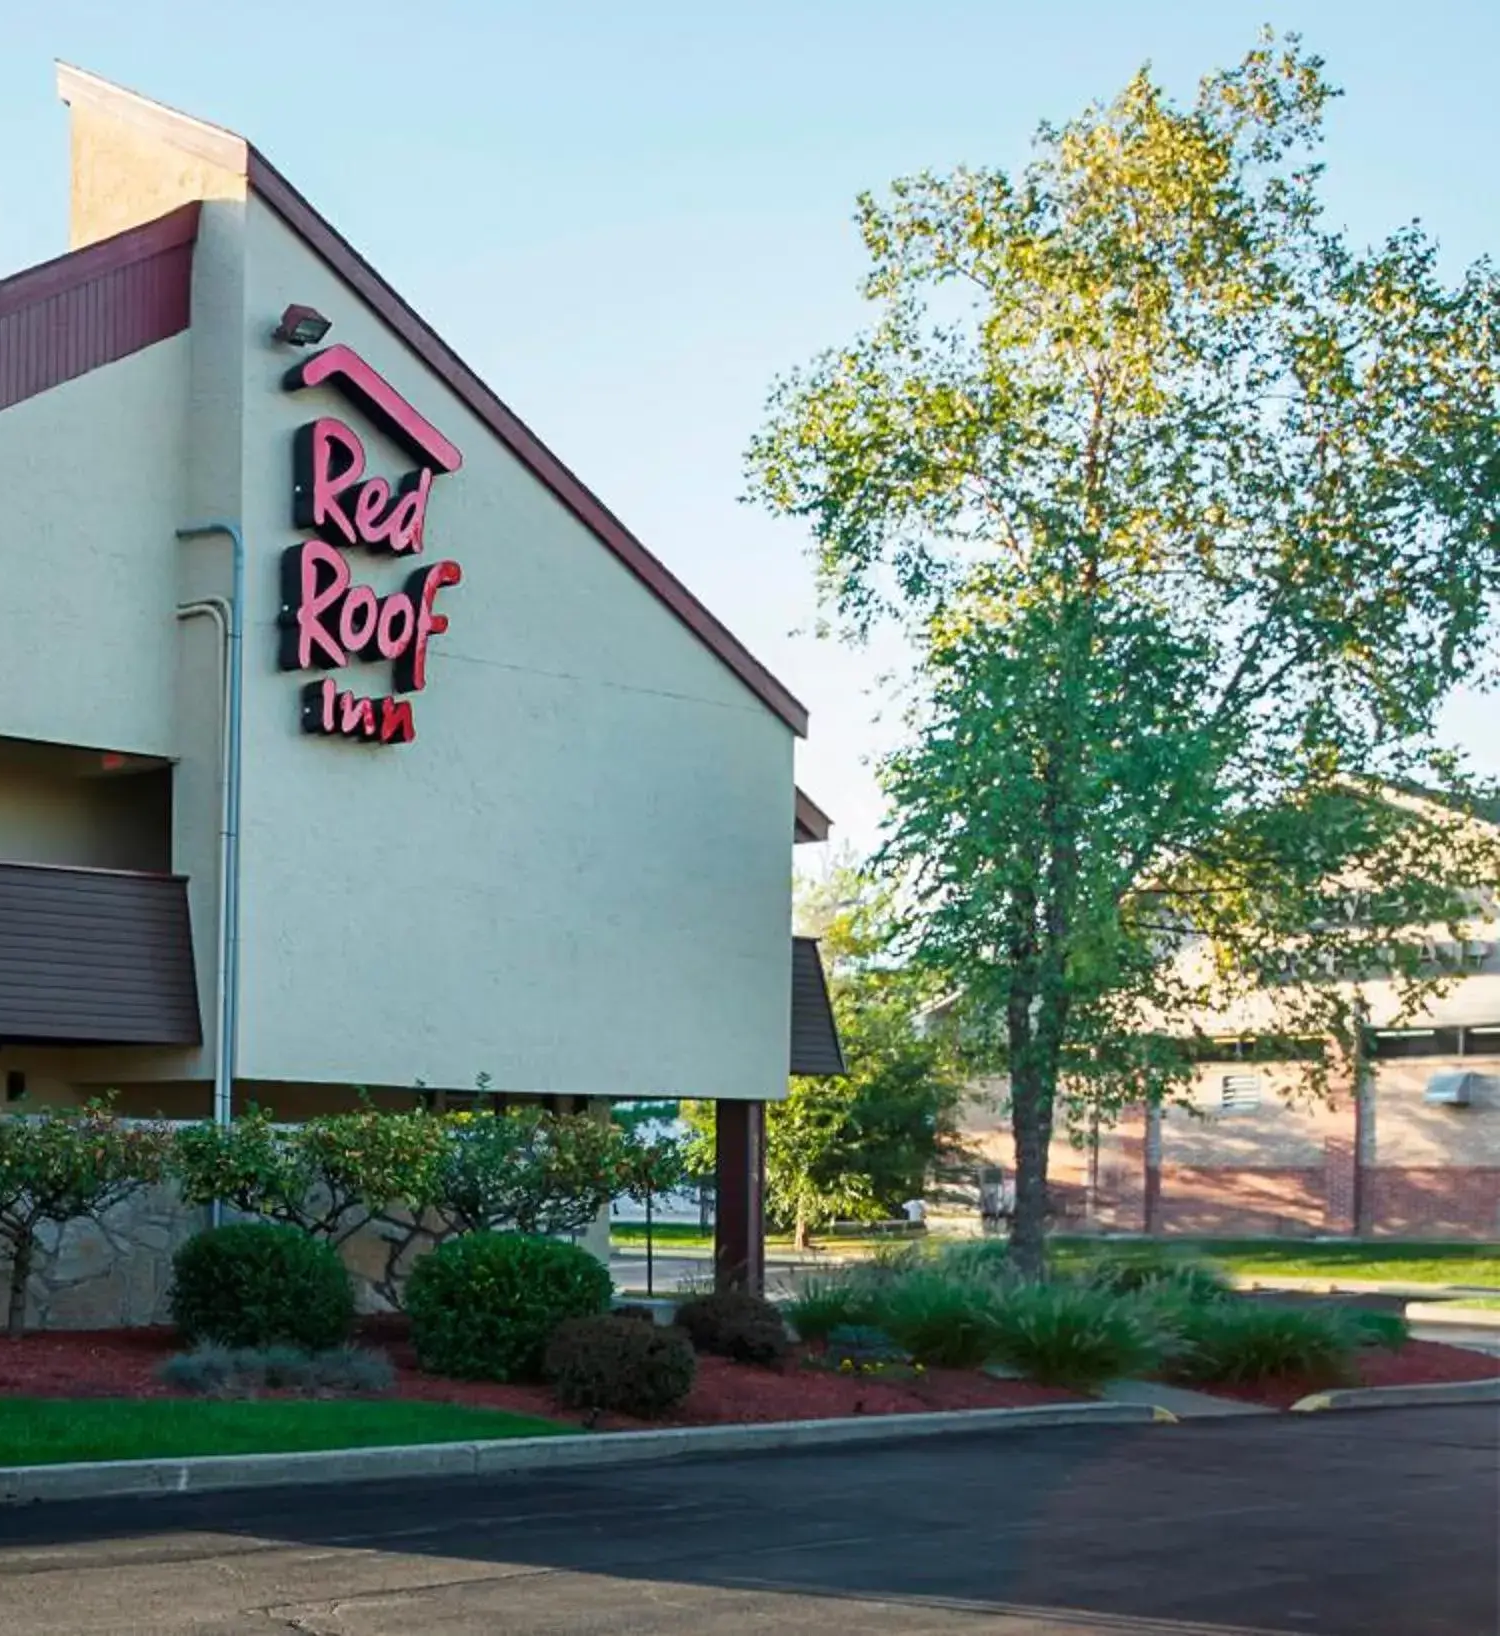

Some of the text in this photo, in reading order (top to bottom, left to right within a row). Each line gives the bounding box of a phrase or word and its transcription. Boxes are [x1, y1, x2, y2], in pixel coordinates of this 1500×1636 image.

[312, 417, 432, 553] Red
[297, 539, 462, 690] Roof
[320, 678, 415, 744] Inn
